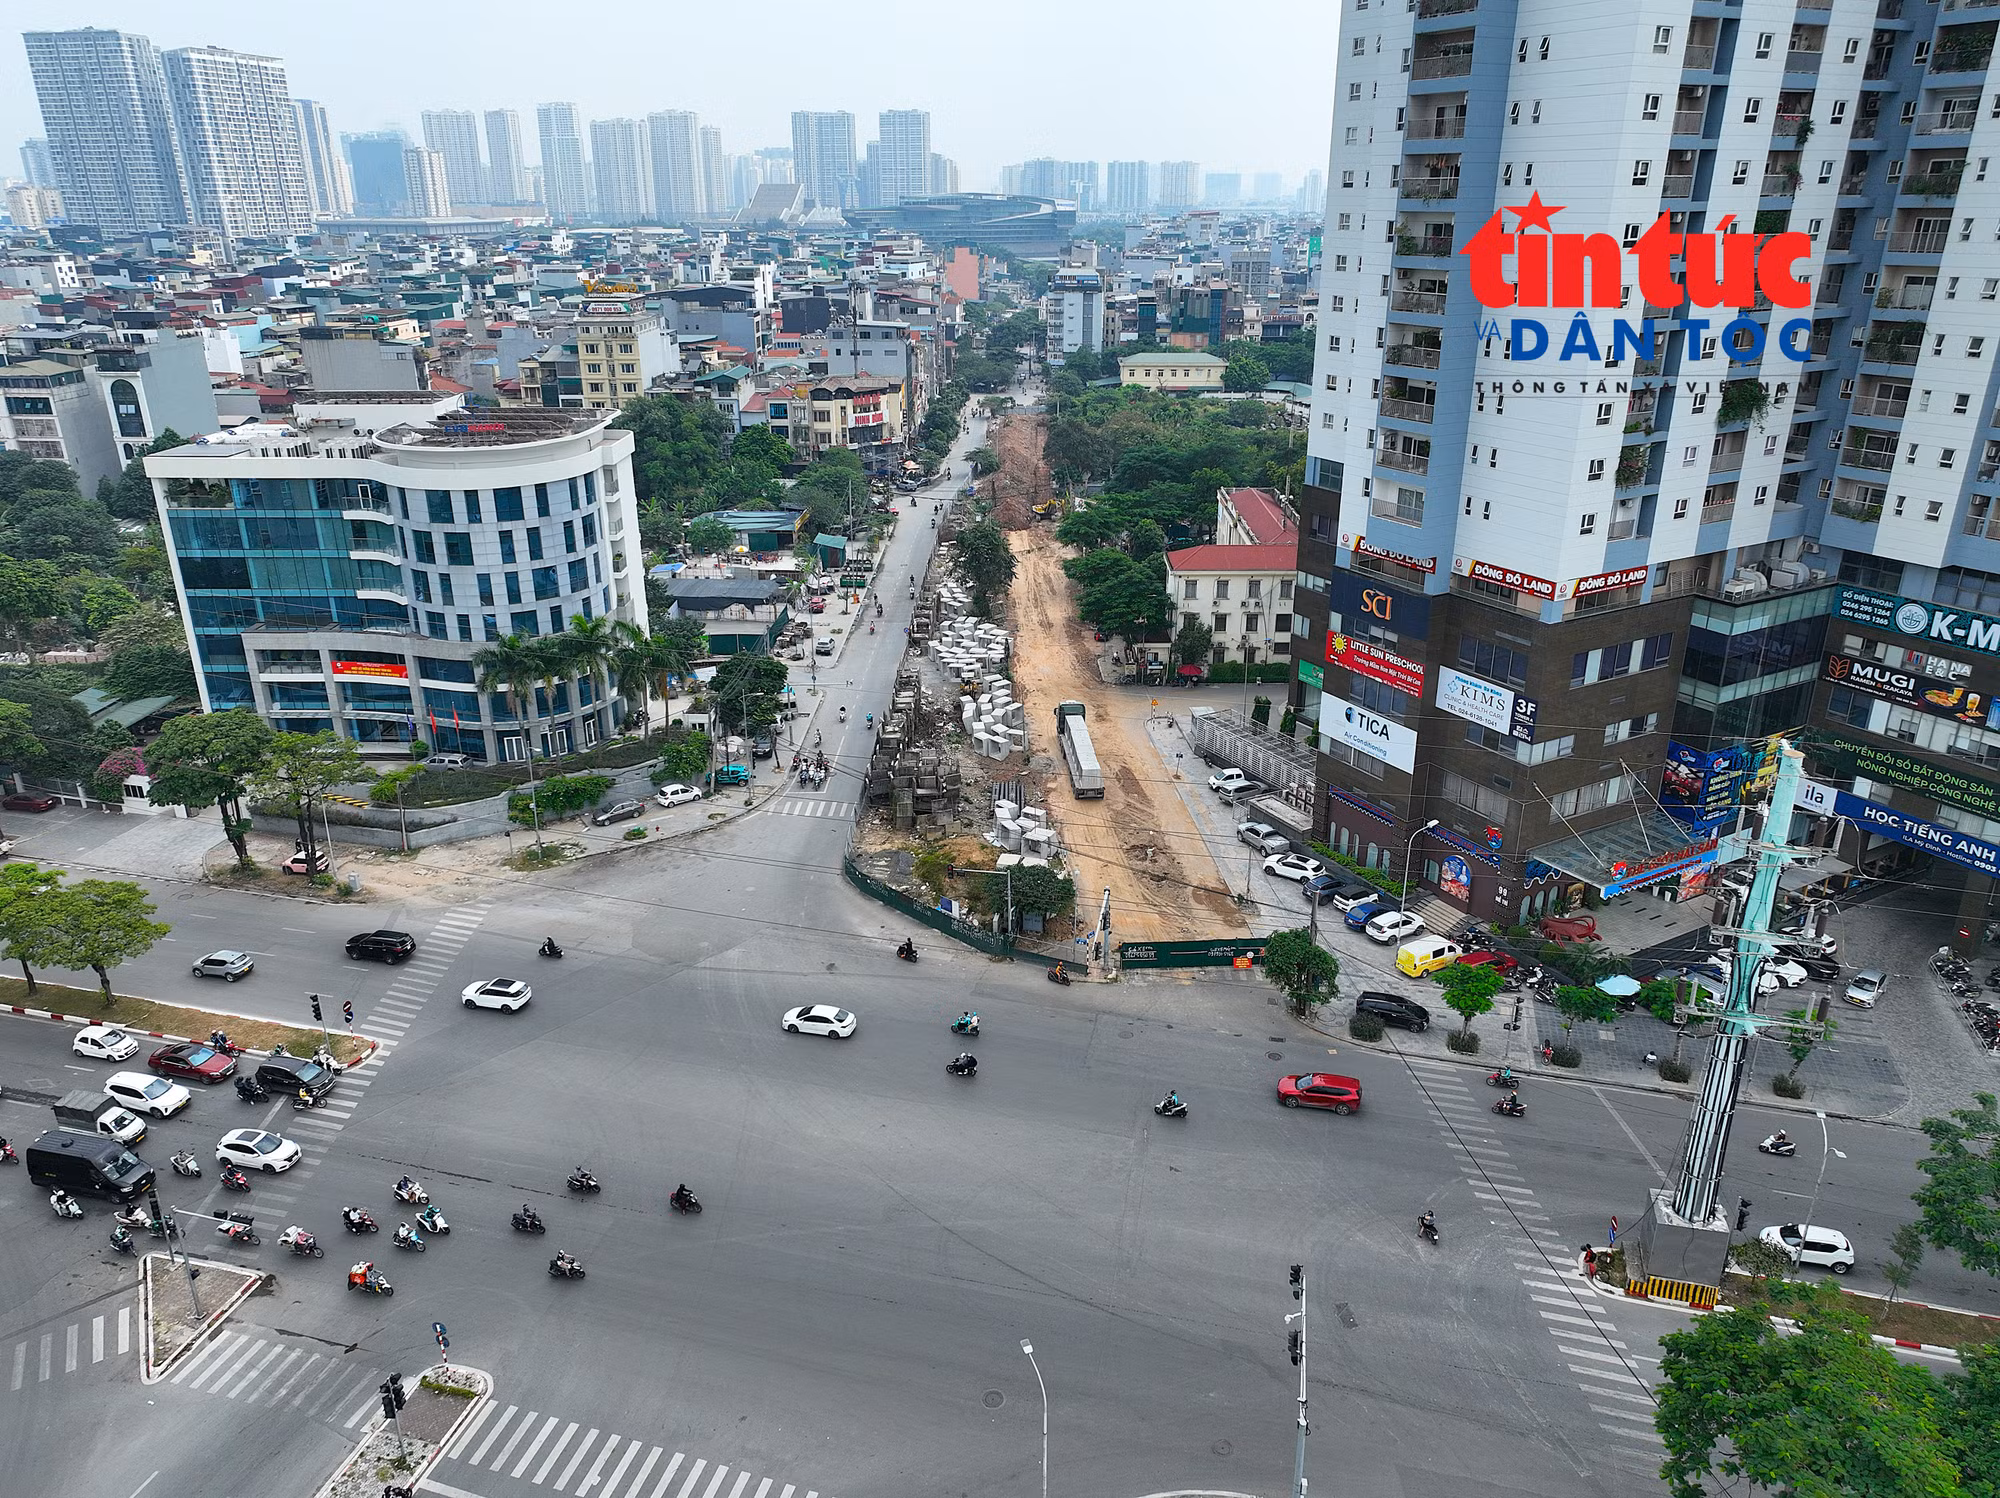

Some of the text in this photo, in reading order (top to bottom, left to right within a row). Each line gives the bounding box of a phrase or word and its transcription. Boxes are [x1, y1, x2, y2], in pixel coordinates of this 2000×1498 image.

[1406, 556, 1434, 568] LAND
[1474, 564, 1504, 580] ĐÔNG
[1506, 573, 1522, 585] ĐÔ
[1524, 578, 1553, 594] LAND
[1579, 576, 1606, 592] ĐÔNG
[1607, 572, 1621, 585] ĐÔ
[1622, 569, 1647, 582] LAND
[1842, 590, 1894, 609] SỐ ĐIỆN THOẠI:
[1842, 600, 1890, 618] 0246 295 1264
[1840, 608, 1853, 618] 024
[1854, 612, 1871, 621] 6295
[1350, 640, 1424, 675] LITTLE SUN PRESCHOOL
[1850, 675, 1876, 686] RAMEN
[1883, 684, 1912, 697] IZAKAYA
[1852, 663, 1916, 690] MUGI
[1444, 694, 1462, 704] CLINIC
[1468, 702, 1488, 714] HEALTH
[1489, 711, 1504, 720] CARE
[1447, 703, 1457, 712] TEL
[1460, 684, 1505, 712] KIMS
[1516, 698, 1536, 716] 3F
[1358, 712, 1390, 740] TICA
[1514, 712, 1530, 721] TOWER
[1344, 731, 1352, 739] Air
[1352, 734, 1388, 756] Conditioning
[1834, 739, 1994, 796] CHUYỂN ĐỔI SỐ BẤT ĐỘNG SẢN
[1805, 784, 1824, 804] ila
[1856, 759, 1886, 775] NÔNG
[1888, 769, 1929, 788] NGHIỆP
[1928, 782, 1962, 800] CÔNG
[1963, 793, 1997, 814] NGHỆ
[1864, 806, 1996, 862] HỌC TIẾNG ANH
[1902, 834, 1914, 842] ILA
[1914, 838, 1924, 848] Mỹ
[1925, 840, 1941, 854] Đình
[1946, 850, 1972, 864] Hotline:
[1974, 860, 1996, 872] 0903
